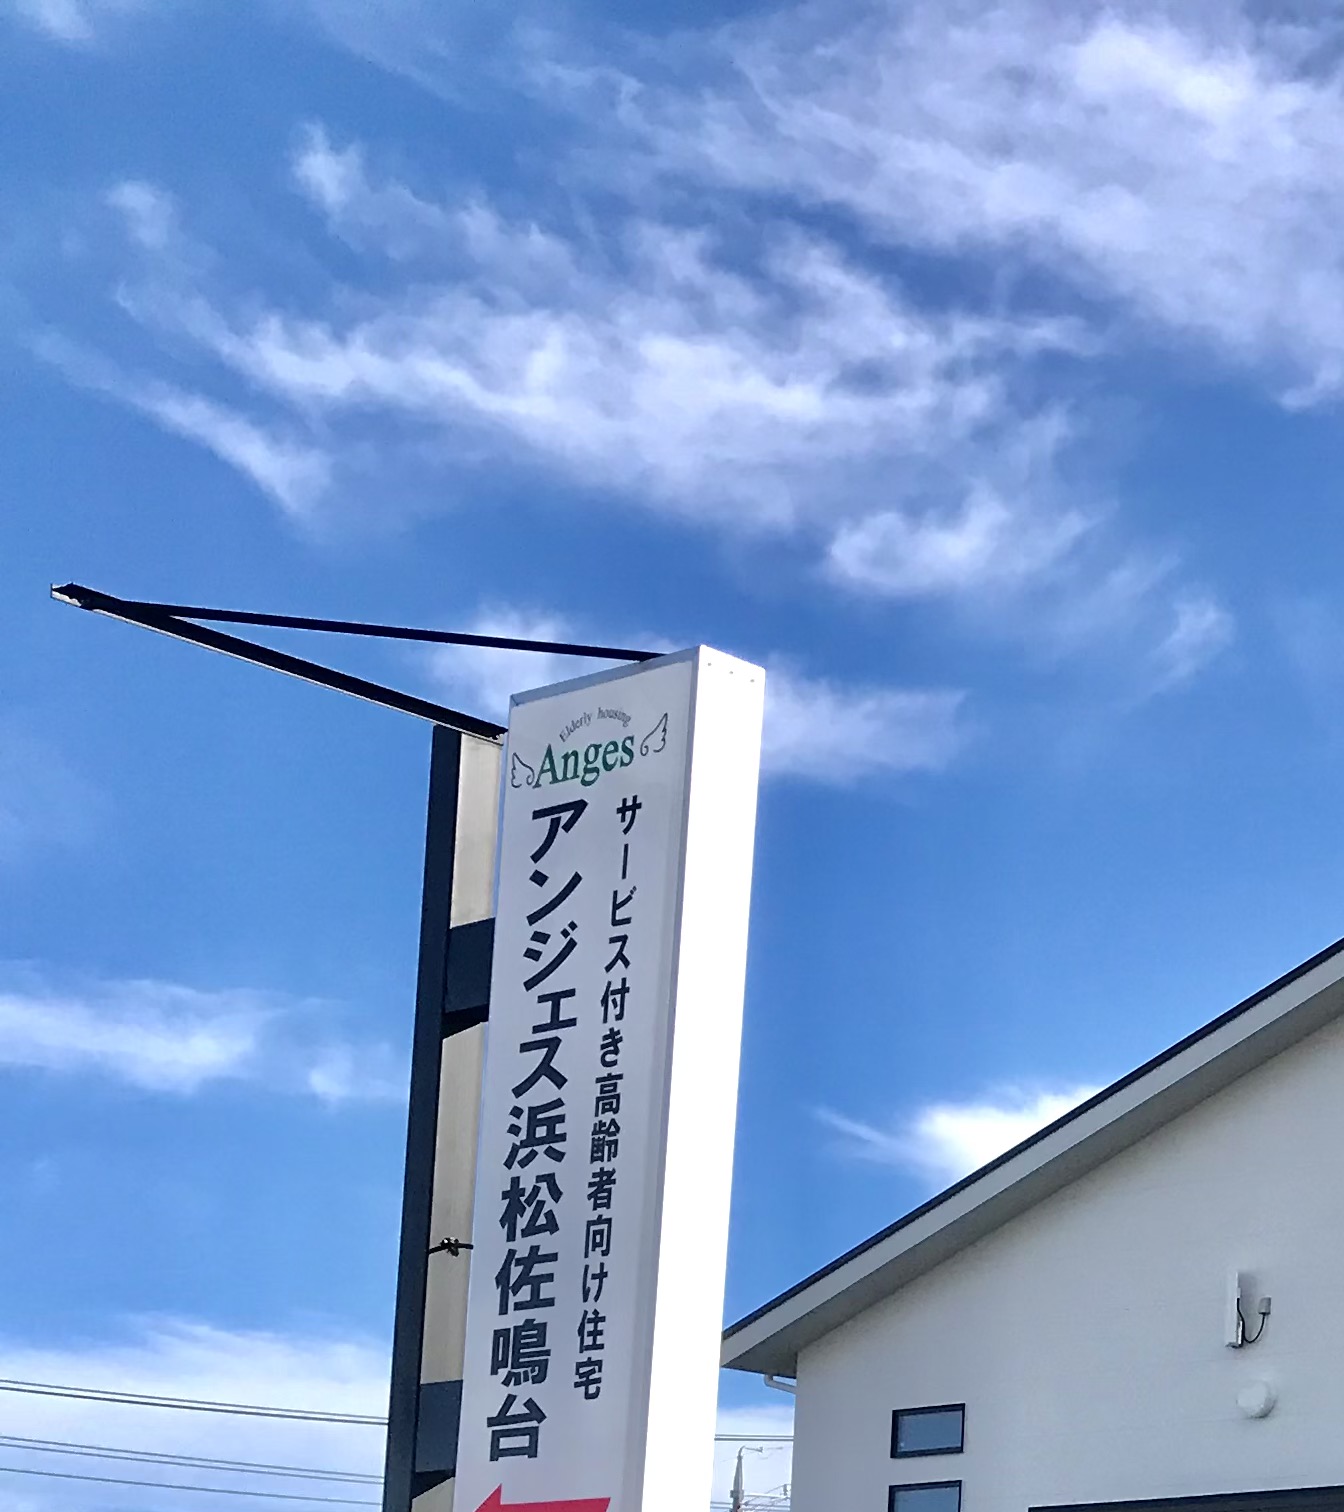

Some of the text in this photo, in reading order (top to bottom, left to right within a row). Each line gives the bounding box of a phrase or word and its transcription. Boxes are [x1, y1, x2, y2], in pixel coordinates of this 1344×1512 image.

[533, 735, 635, 788] Anges
[559, 712, 592, 742] Elderly
[486, 798, 589, 1462] アンジェス浜松佐鳴台
[573, 794, 643, 1401] サービス付き高齢者向け住宅
